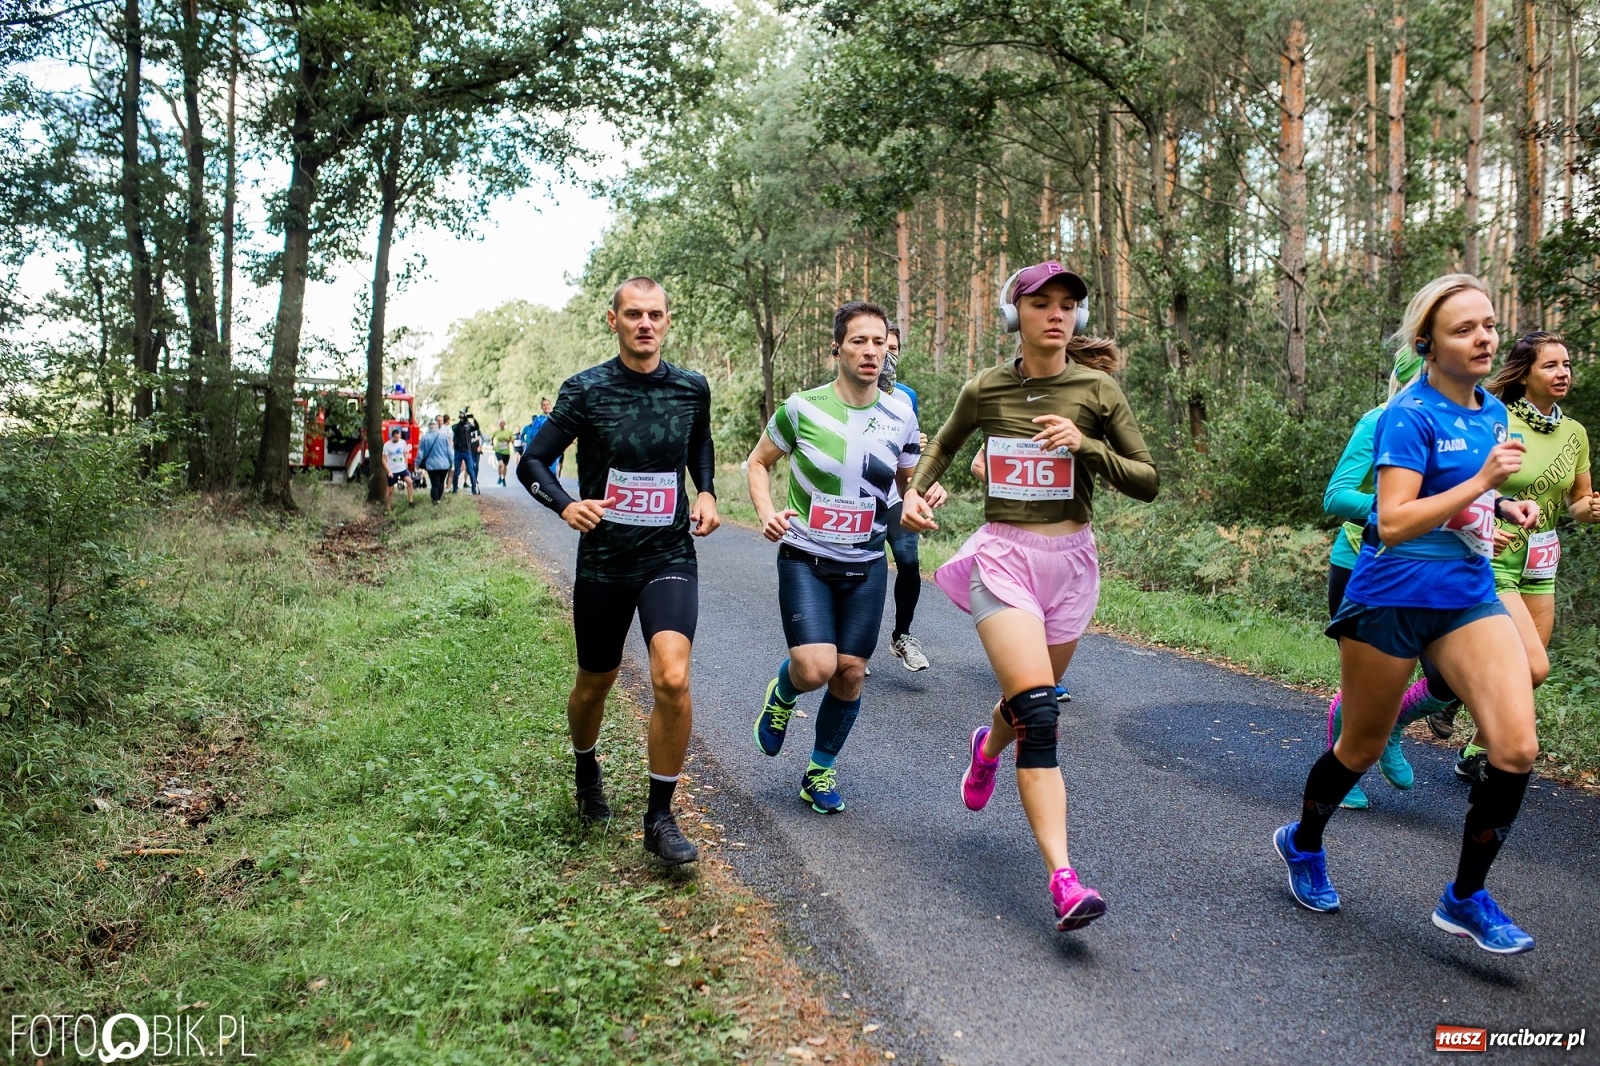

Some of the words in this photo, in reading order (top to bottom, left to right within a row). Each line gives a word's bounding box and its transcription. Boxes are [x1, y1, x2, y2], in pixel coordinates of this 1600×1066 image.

[1005, 459, 1054, 485] 216
[616, 489, 666, 513] 230
[823, 510, 862, 532] 221
